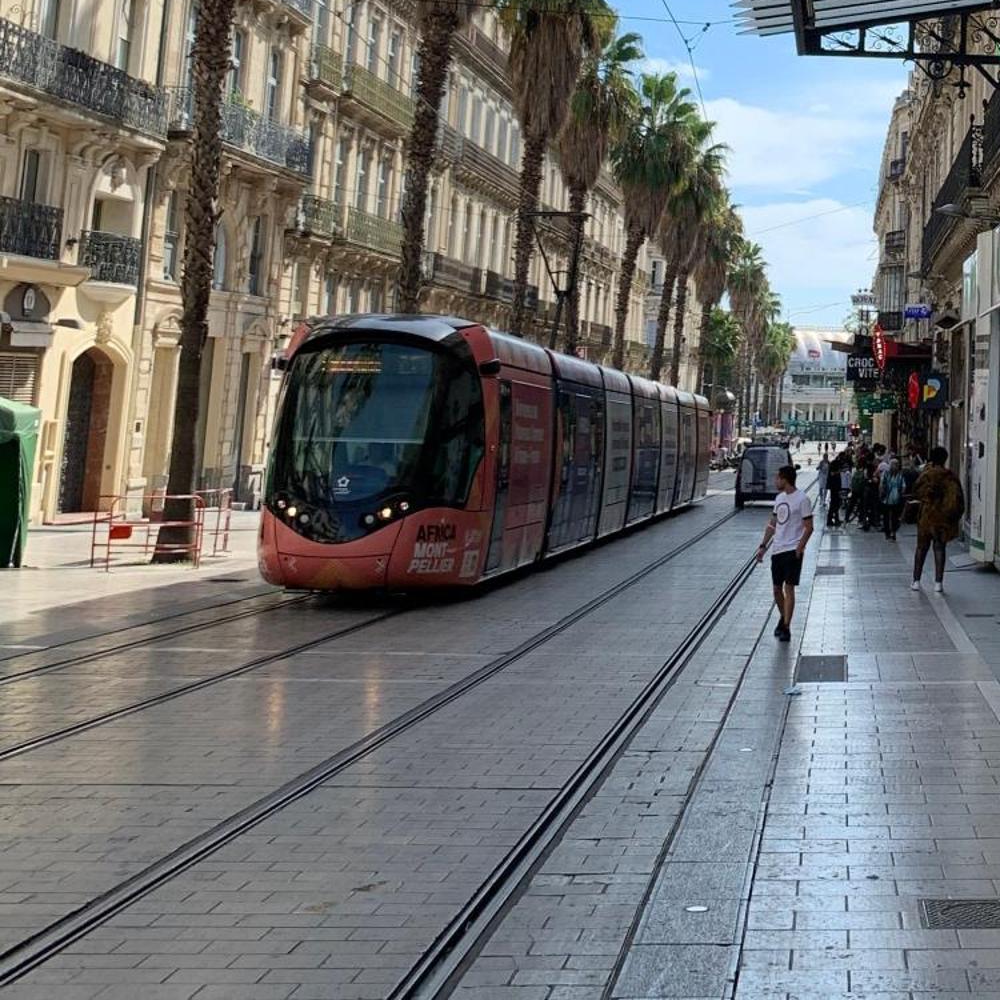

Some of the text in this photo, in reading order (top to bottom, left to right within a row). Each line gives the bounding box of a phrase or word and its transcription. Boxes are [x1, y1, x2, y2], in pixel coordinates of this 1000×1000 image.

[848, 357, 874, 368] CROC
[858, 367, 880, 379] VITE
[416, 523, 457, 542] AFRICA
[407, 557, 456, 574] PELLIER
